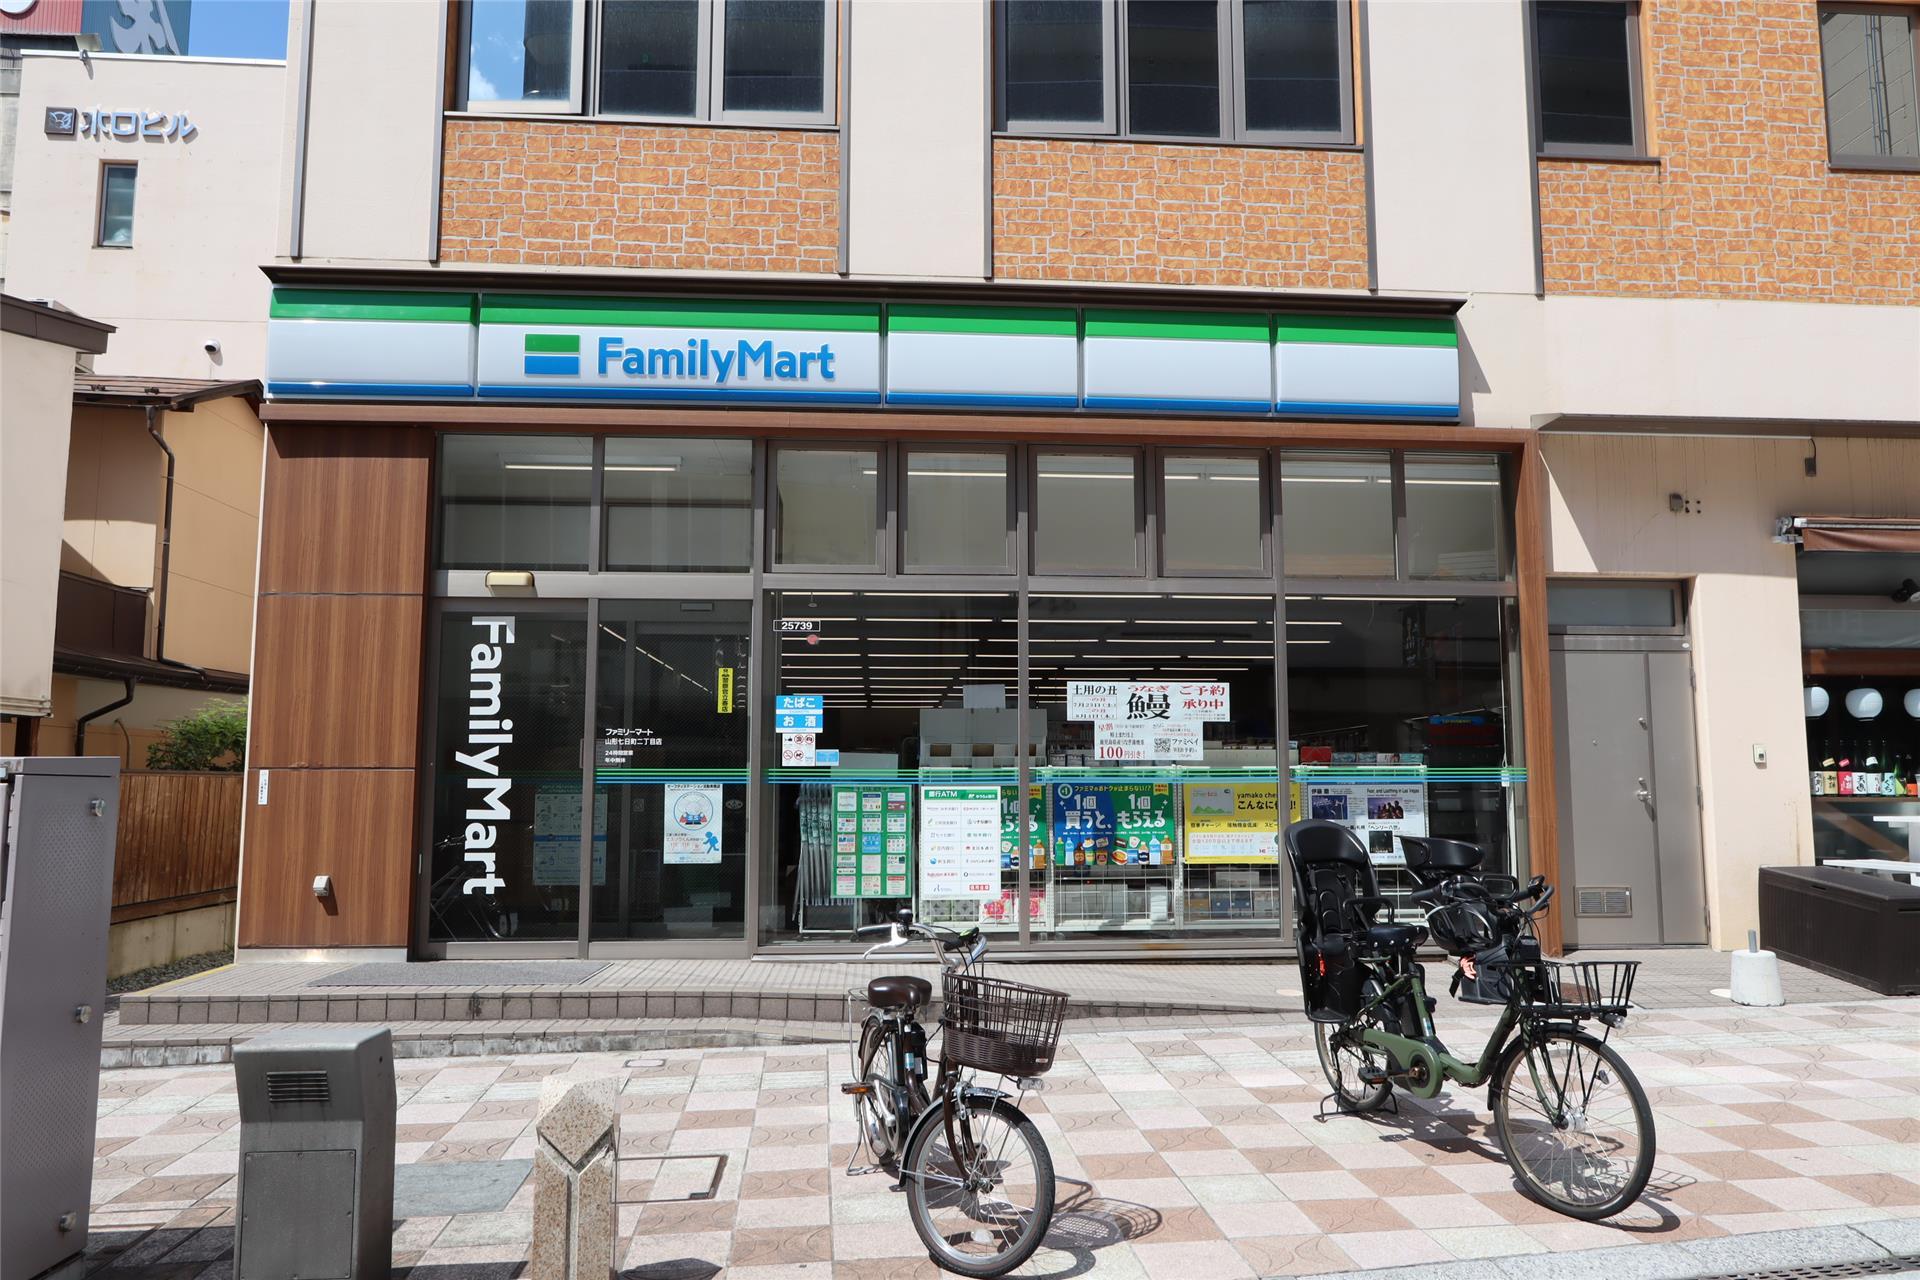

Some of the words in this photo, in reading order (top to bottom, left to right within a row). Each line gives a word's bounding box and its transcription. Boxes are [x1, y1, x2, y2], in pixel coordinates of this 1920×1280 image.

[80, 105, 198, 138] 水口ビル
[598, 337, 836, 384] FamilyMart
[781, 621, 813, 630] 25739
[1073, 685, 1118, 695] 土用の丑
[1180, 685, 1225, 696] ご予約
[783, 697, 816, 708] たばこ
[1126, 693, 1171, 720] 鰻
[1183, 699, 1223, 709] 承り中
[605, 728, 654, 736] ファミリーマート
[604, 737, 663, 746] 山形七日町二丁目店
[455, 616, 516, 895] FamilyMart
[1074, 793, 1097, 810] 1個
[1128, 793, 1151, 810] 1個
[1117, 810, 1166, 829] もらえる
